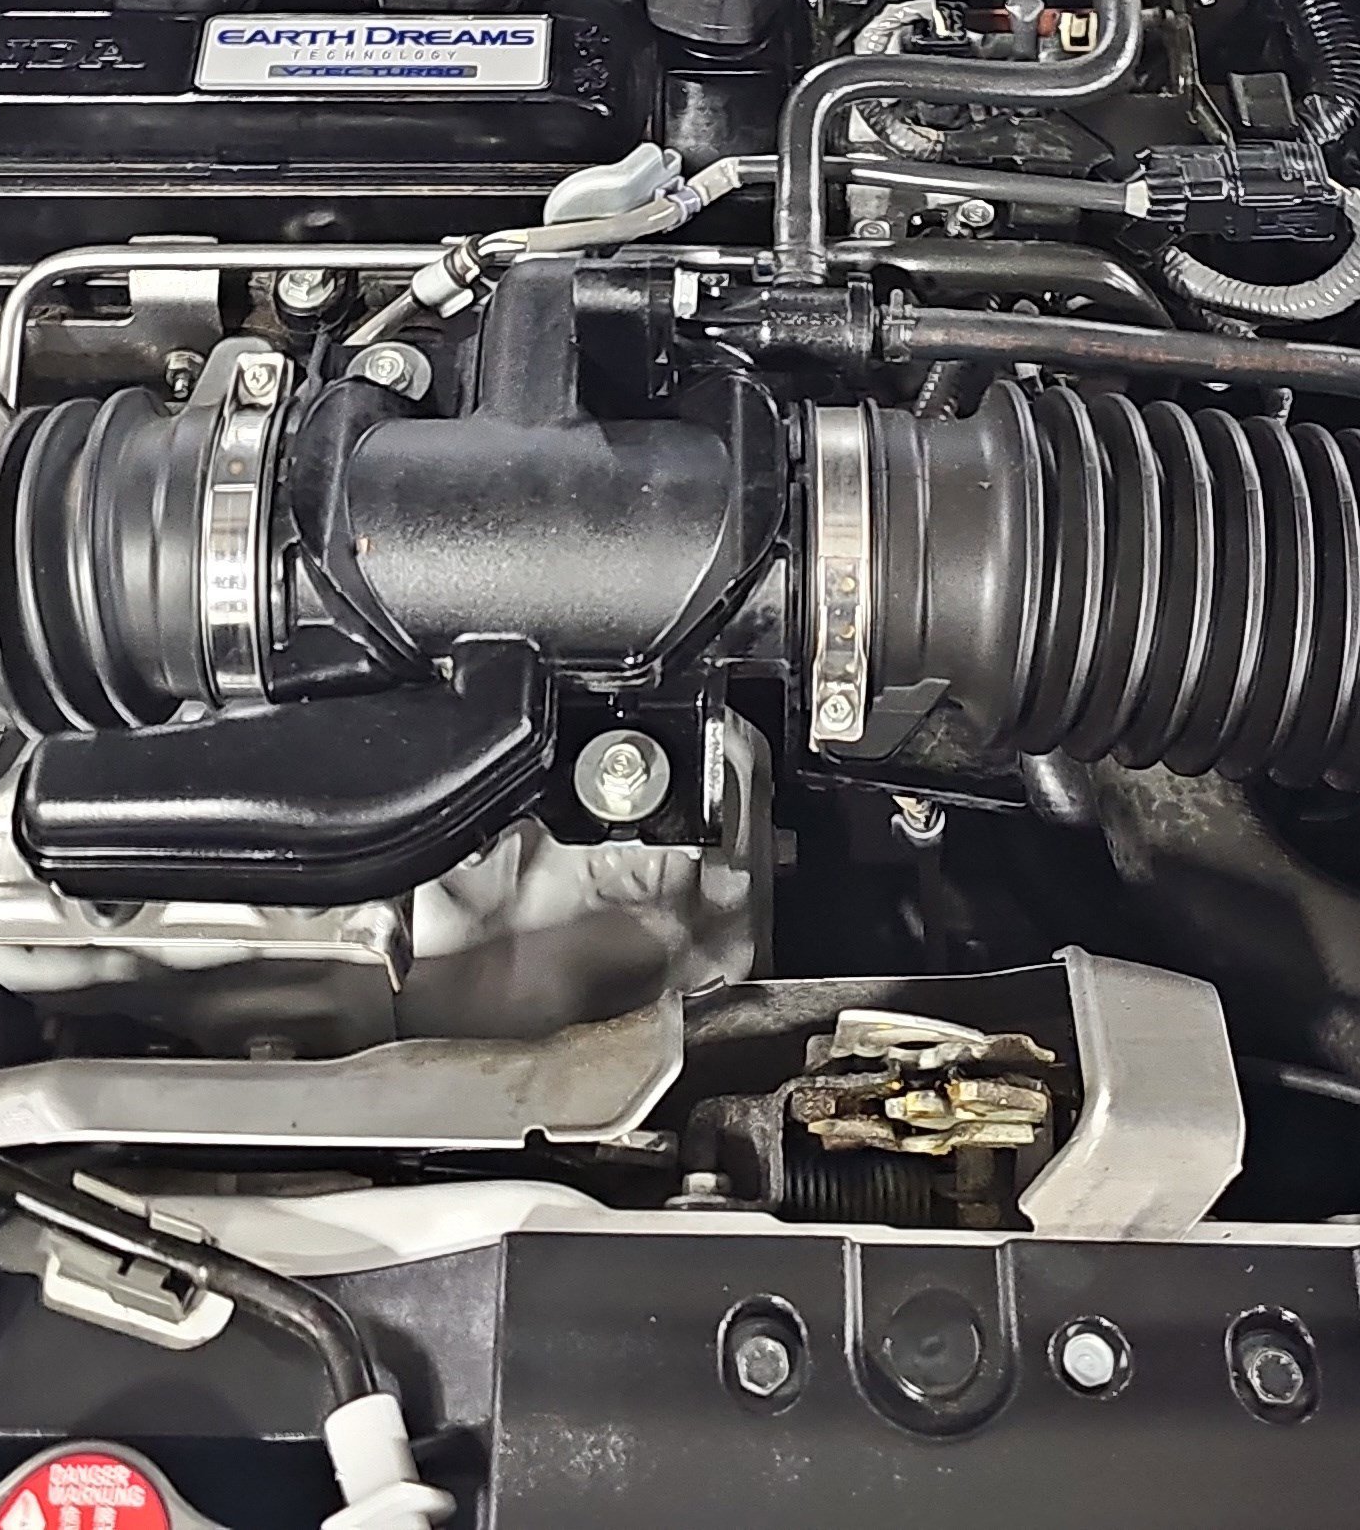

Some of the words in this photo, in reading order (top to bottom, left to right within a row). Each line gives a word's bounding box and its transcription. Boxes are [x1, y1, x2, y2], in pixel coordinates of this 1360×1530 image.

[217, 28, 354, 46] EARTH
[365, 26, 536, 47] DREAMS
[291, 49, 458, 61] TECHNOLOGY
[281, 66, 361, 77] VTEC
[49, 1463, 133, 1486] DANGER
[48, 1484, 146, 1508] WARNING
